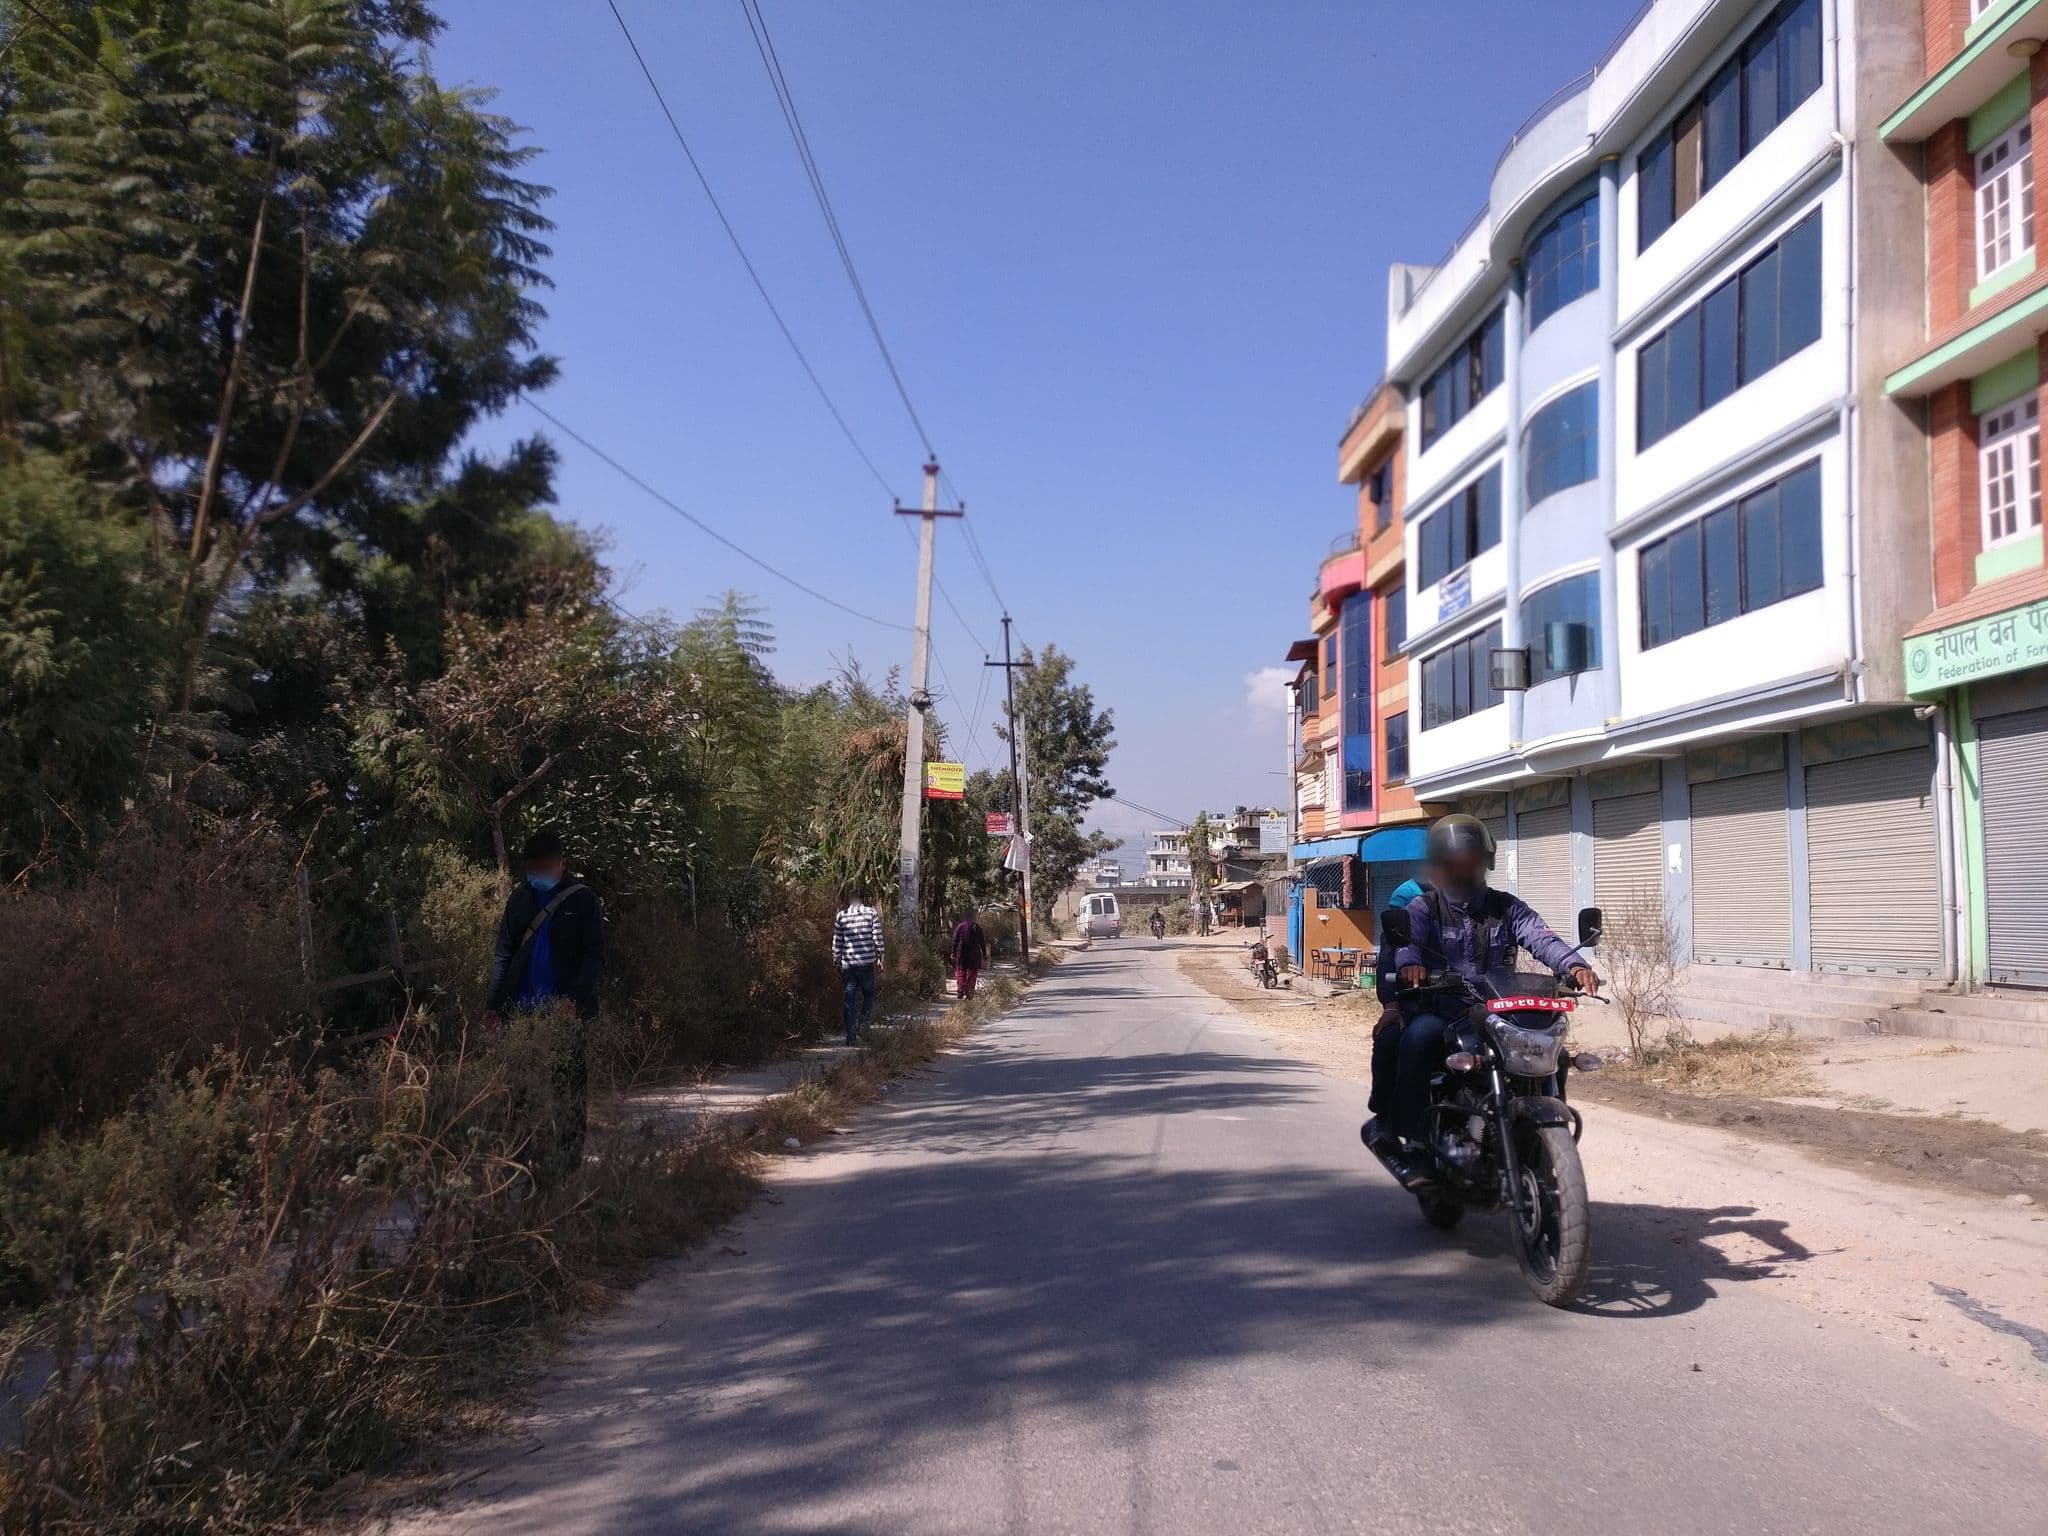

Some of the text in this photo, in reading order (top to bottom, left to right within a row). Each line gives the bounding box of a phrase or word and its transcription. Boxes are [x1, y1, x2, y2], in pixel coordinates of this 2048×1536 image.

[1934, 626, 1979, 660] नेपाल
[1988, 615, 2018, 646] वन
[1938, 656, 2000, 680] Federation
[2005, 647, 2020, 663] of
